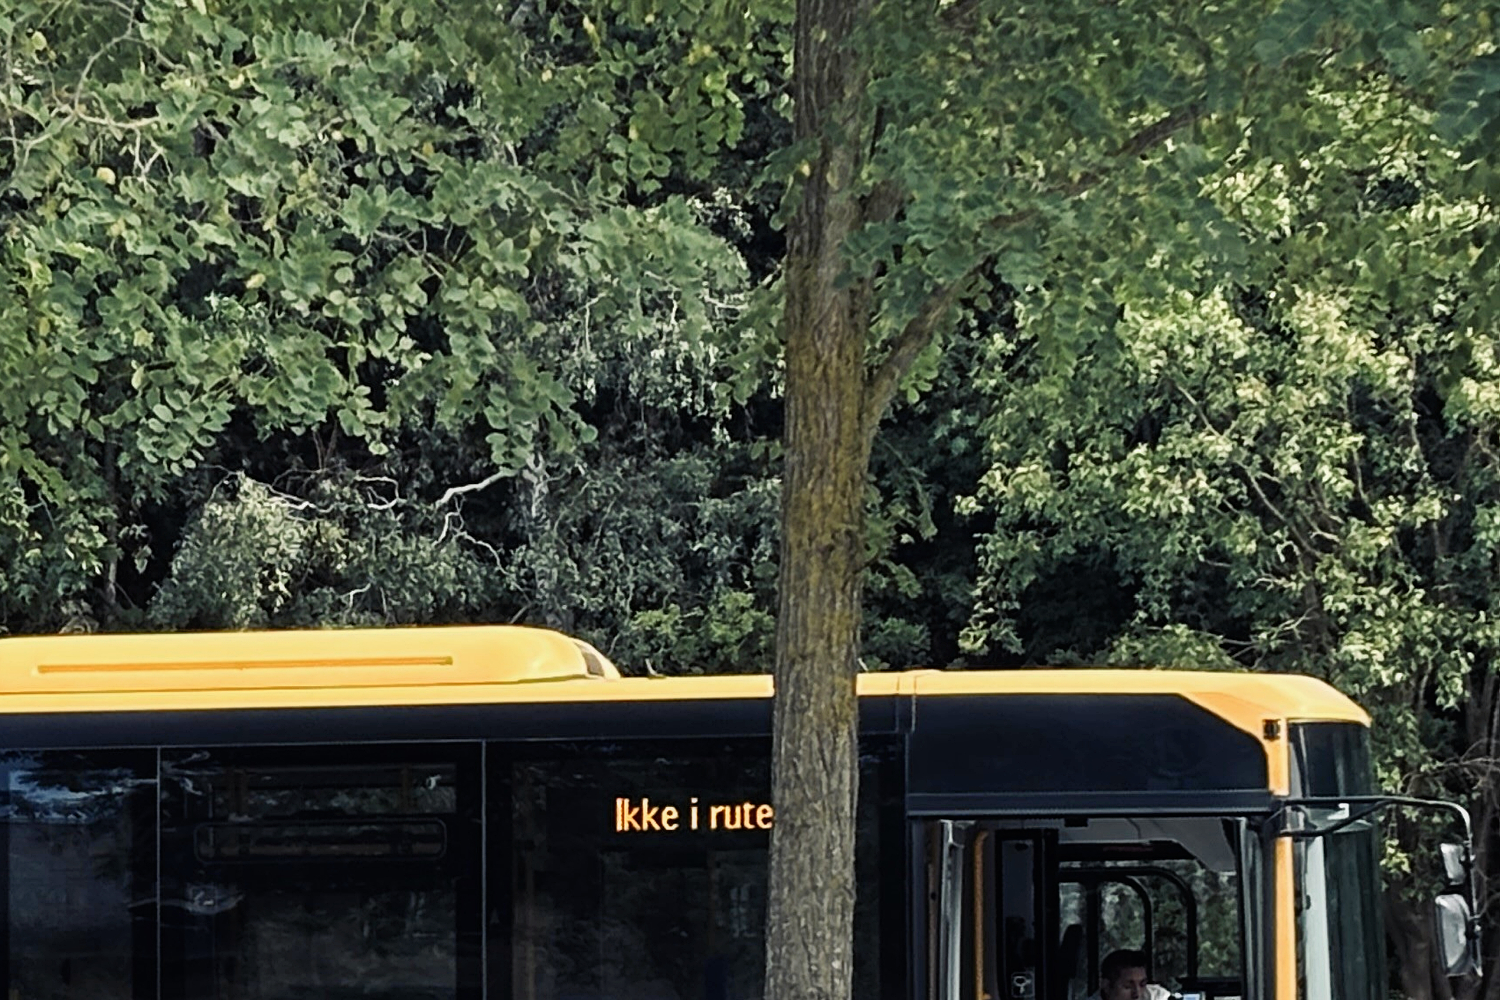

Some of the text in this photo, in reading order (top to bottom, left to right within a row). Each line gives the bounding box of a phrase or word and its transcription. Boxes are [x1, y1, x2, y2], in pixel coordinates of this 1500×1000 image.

[615, 797, 774, 831] Ikke i rute
